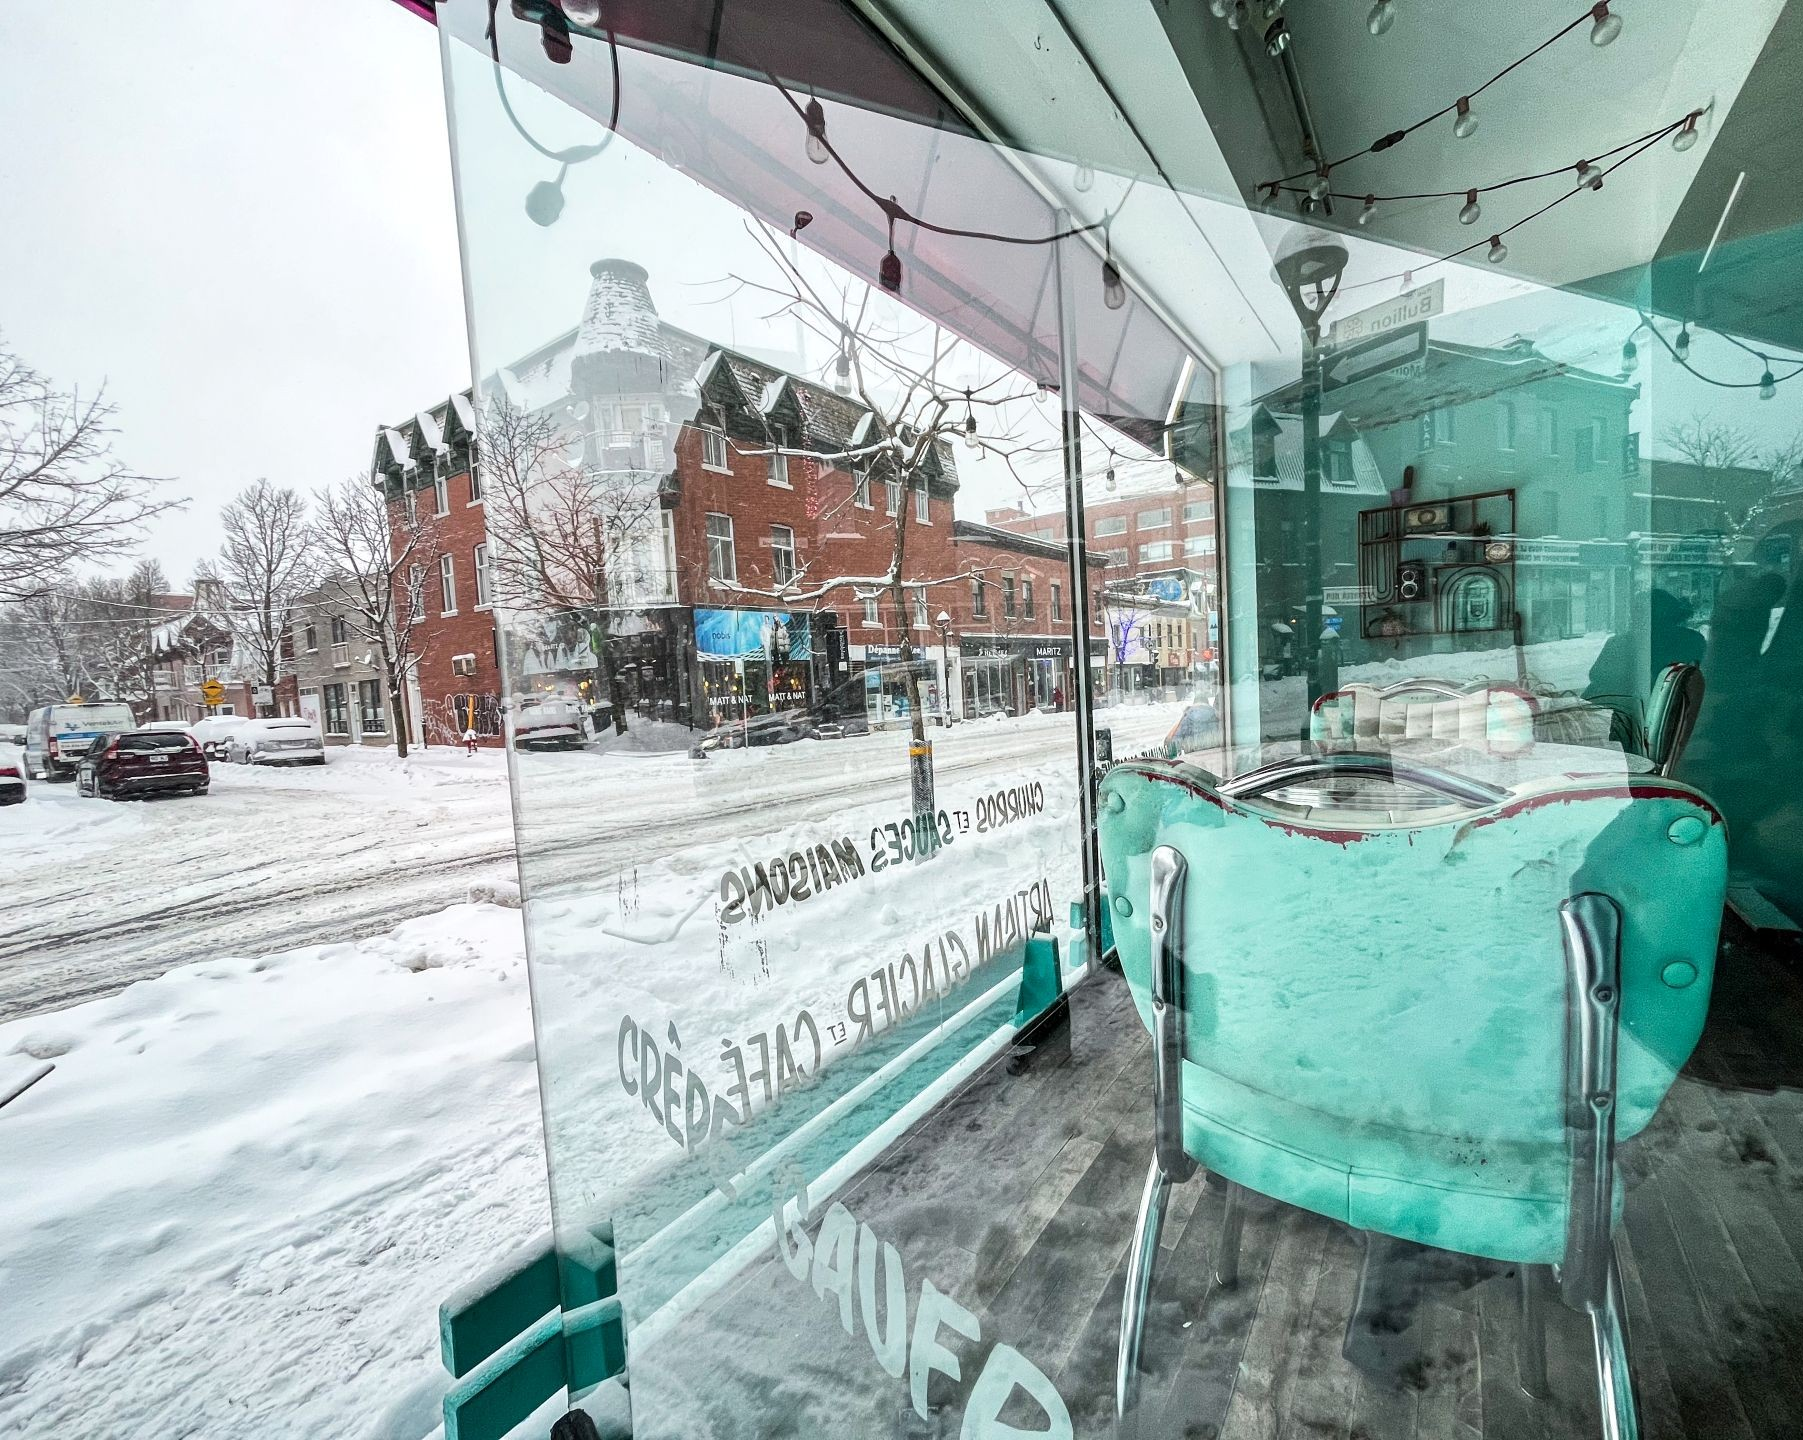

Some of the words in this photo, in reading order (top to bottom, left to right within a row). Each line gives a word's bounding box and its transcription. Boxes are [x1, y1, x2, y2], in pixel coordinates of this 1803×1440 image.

[868, 644, 902, 655] Dépanne
[1036, 647, 1062, 656] MARITZ
[709, 696, 730, 706] MATT
[730, 696, 737, 704] &
[738, 694, 753, 704] NAT
[768, 692, 786, 702] MATT
[786, 692, 792, 700] &
[792, 691, 806, 700] NAT
